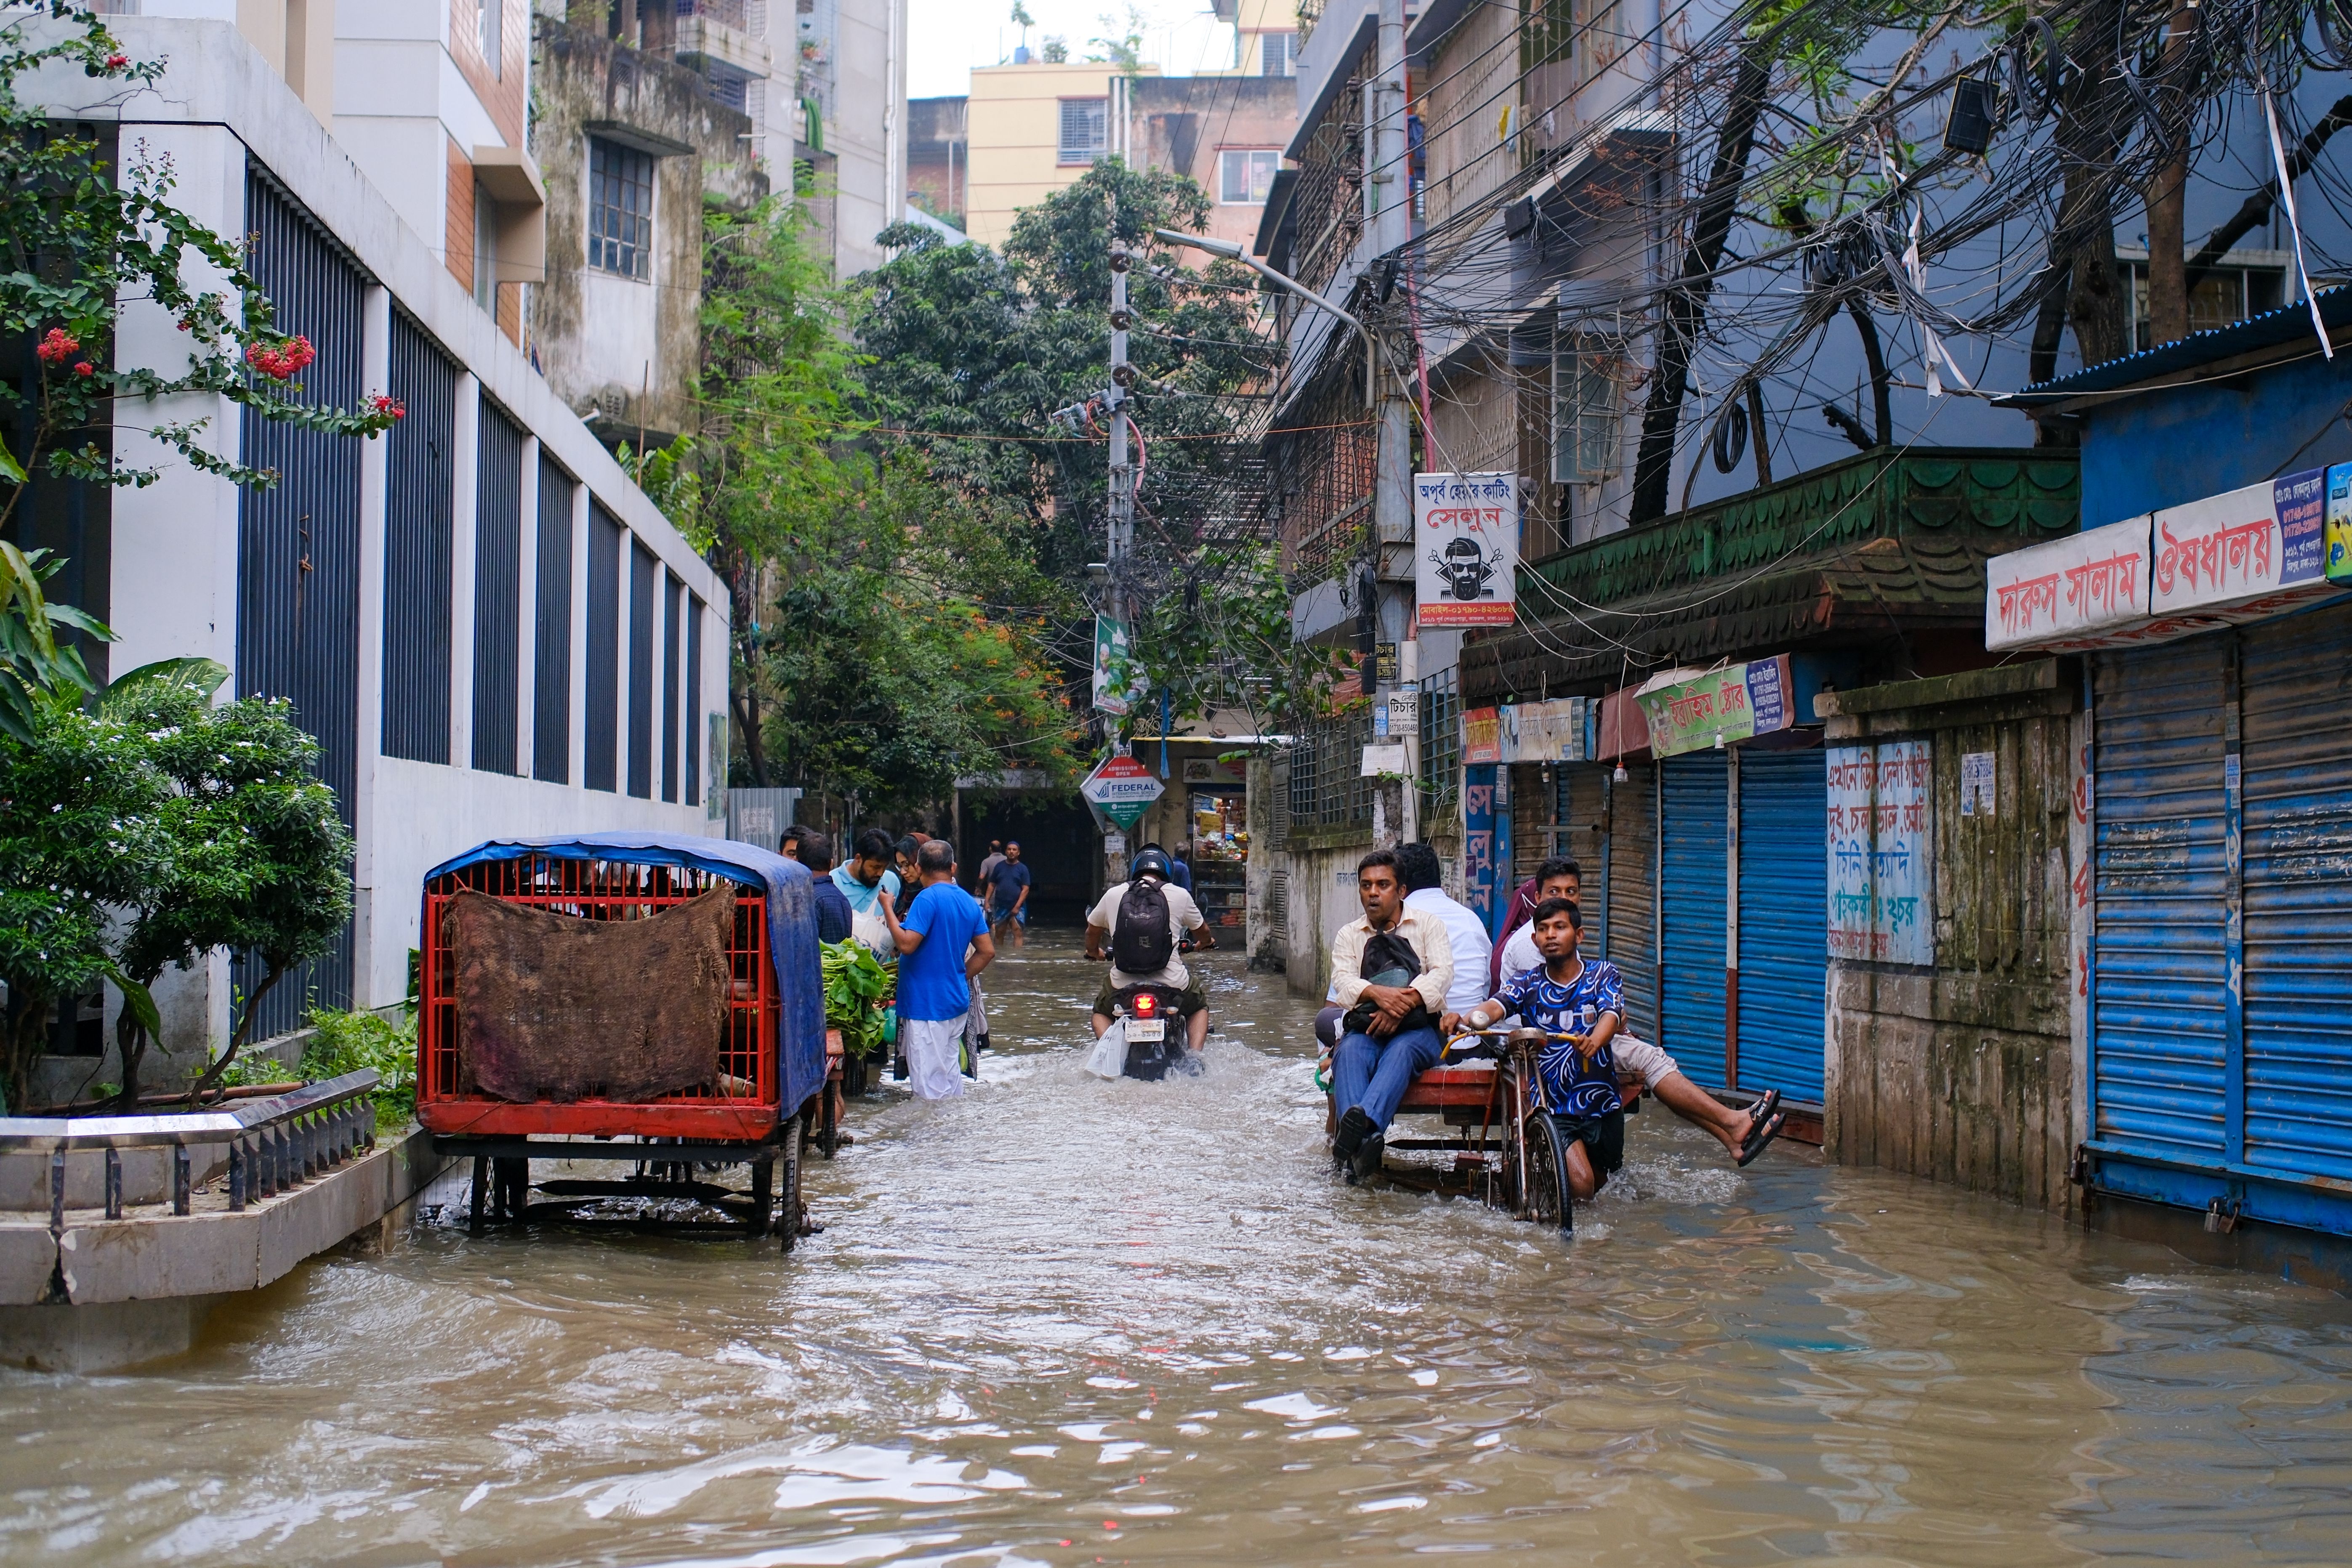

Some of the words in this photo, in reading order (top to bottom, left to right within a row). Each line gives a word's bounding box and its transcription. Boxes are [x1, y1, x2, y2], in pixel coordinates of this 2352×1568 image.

[1419, 479, 1447, 505] অপূর্ব
[1482, 478, 1511, 500] কাটিং
[1427, 508, 1504, 532] সেলুন
[1996, 573, 2061, 637] দারুস
[2065, 549, 2142, 622] সালাম
[2156, 518, 2275, 595] ঔষধালয়
[1390, 699, 1416, 714] টিচার
[1402, 693, 1417, 702] লেডি
[1664, 686, 1713, 728] ইব্রাহিম
[1389, 724, 1418, 732] 01730-850460
[1835, 840, 1862, 879] চিনি
